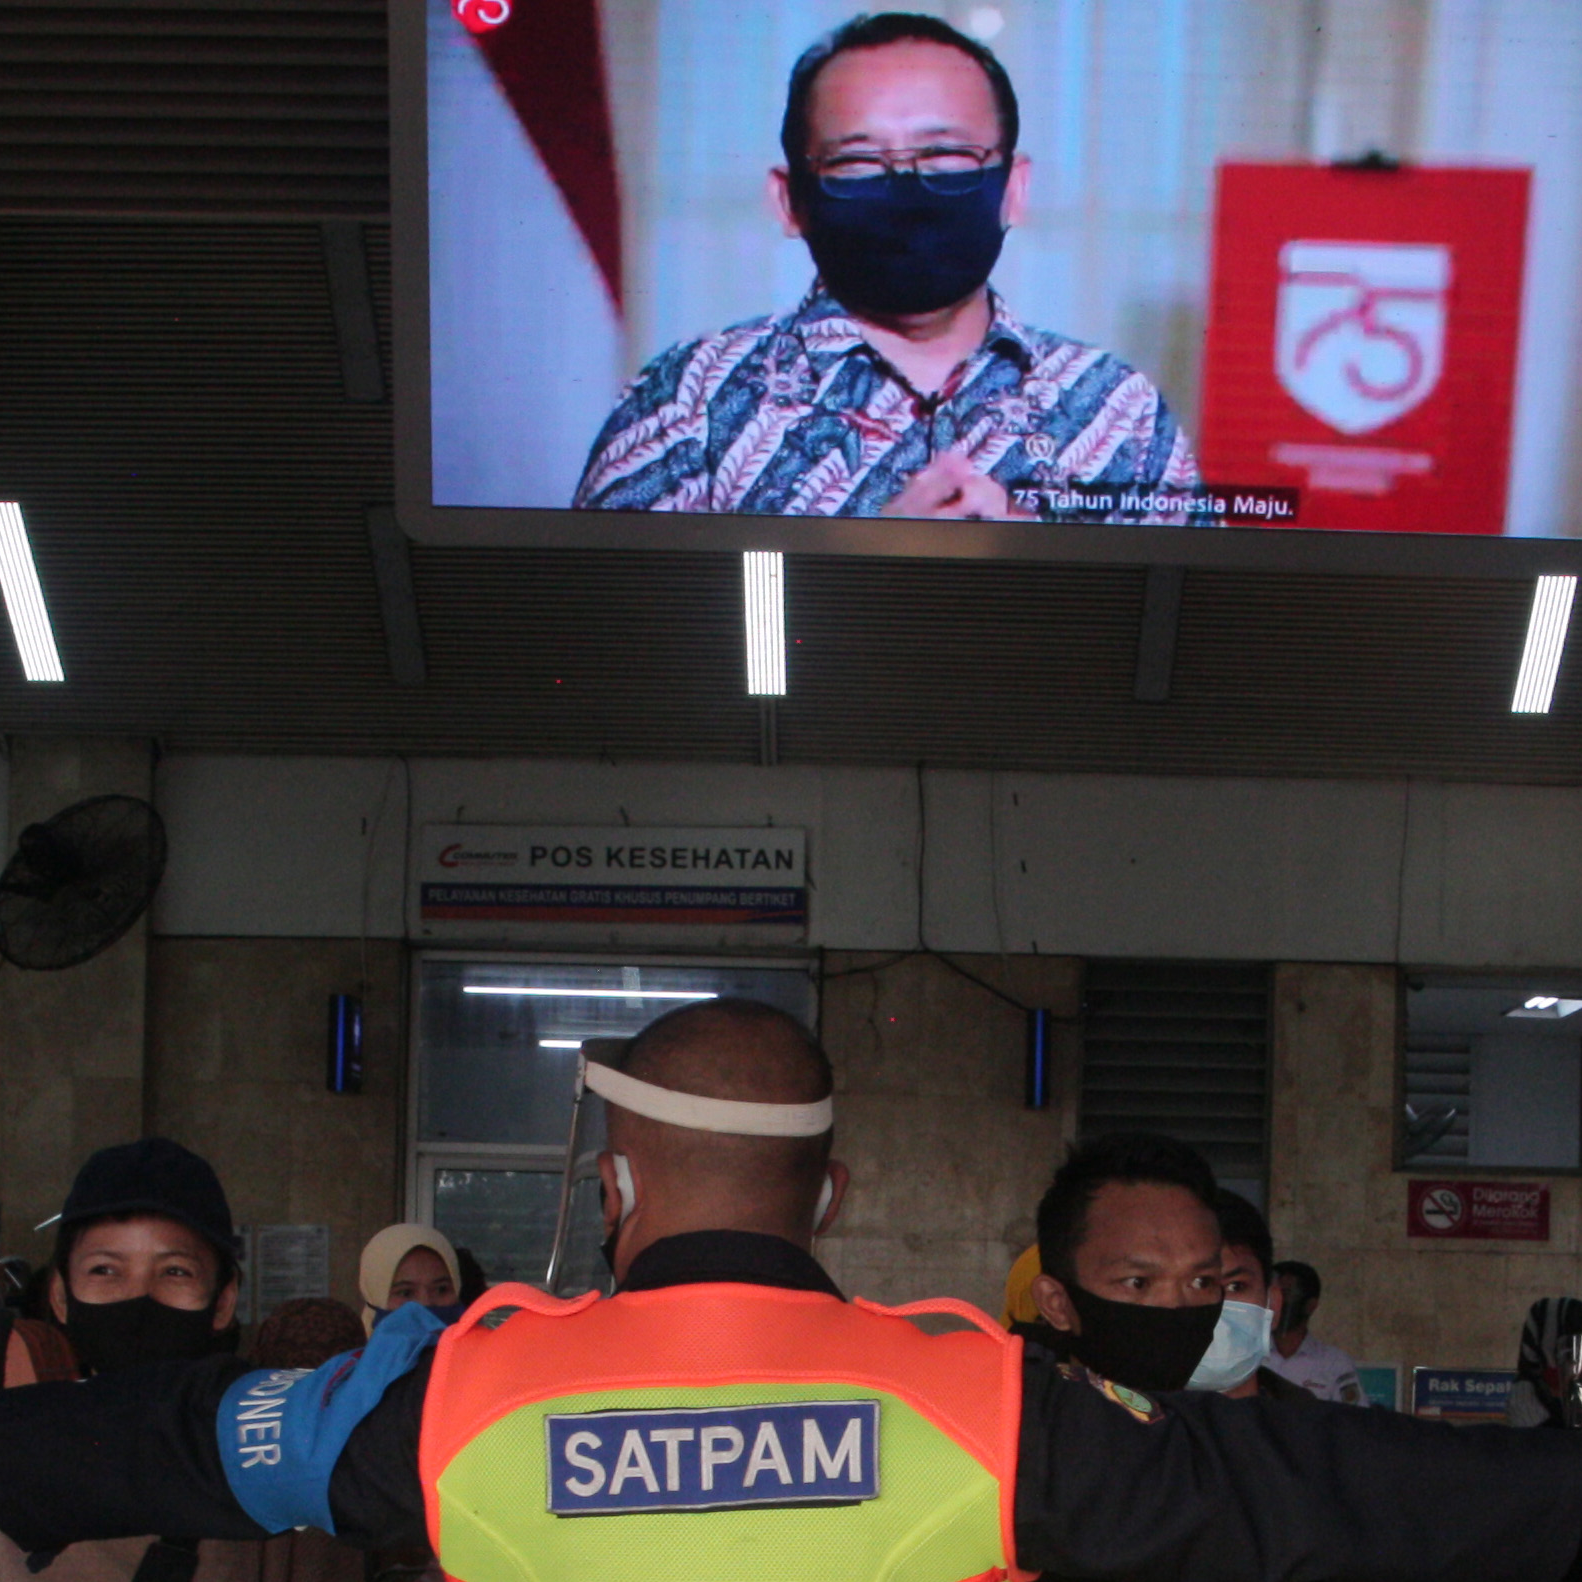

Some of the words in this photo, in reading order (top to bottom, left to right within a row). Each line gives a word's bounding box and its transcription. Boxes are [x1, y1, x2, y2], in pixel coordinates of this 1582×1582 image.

[1013, 488, 1039, 507] 75
[1047, 491, 1113, 510] Tahun
[1120, 492, 1226, 513] Indonesia
[1233, 495, 1294, 520] Maju.
[530, 845, 593, 868] POS
[606, 847, 794, 870] KESEHATAN
[428, 888, 496, 901] PELAYANAN
[498, 888, 567, 902] KESEHATAN
[569, 889, 612, 904] GRATIS
[614, 890, 663, 905] KHUSUS
[664, 891, 738, 906] PENUMPANG
[740, 892, 797, 907] BERTIKET
[1428, 1377, 1460, 1393] Rak
[1465, 1378, 1511, 1397] Sepat
[564, 1417, 863, 1498] SATPAM
